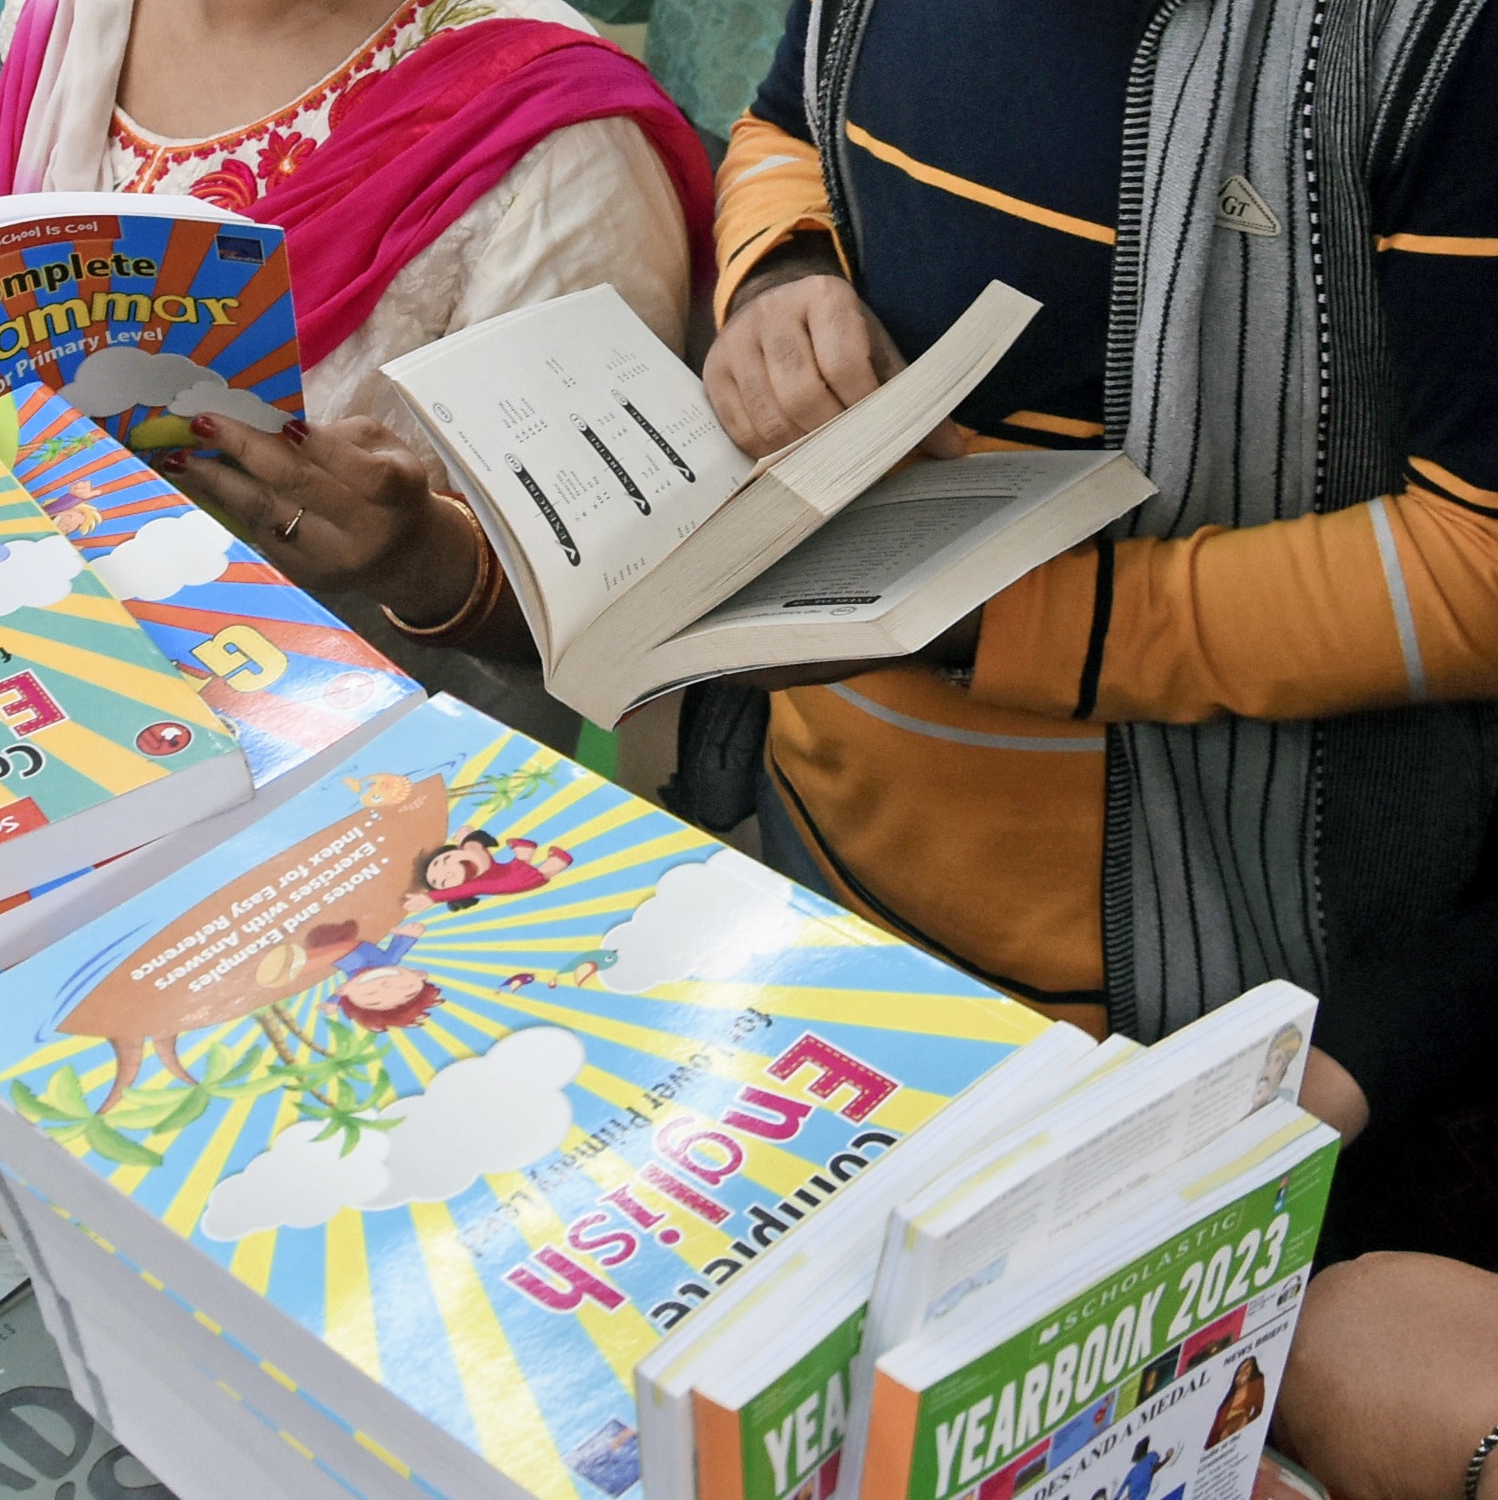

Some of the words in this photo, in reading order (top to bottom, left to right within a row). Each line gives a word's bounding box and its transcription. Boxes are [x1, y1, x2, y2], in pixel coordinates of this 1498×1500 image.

[46, 224, 61, 235] Is
[65, 221, 98, 234] Cool
[15, 333, 100, 378] Primary
[104, 327, 163, 346] Level
[587, 433, 635, 493] EXERCISE
[630, 409, 678, 463] EXERCISE
[523, 475, 567, 540] EXERCISE
[279, 864, 310, 889] for
[289, 841, 377, 903] Exercises
[308, 826, 365, 867] Index
[230, 885, 278, 919] Easy
[322, 862, 381, 904] Notes
[241, 900, 289, 934] with
[283, 901, 322, 934] and
[130, 915, 231, 981] Reference
[154, 931, 240, 991] Answers
[188, 927, 284, 993] Examples
[728, 1007, 774, 1043] for
[643, 1042, 734, 1111] Lower
[501, 1029, 905, 1314] English
[527, 1106, 654, 1193] Primary
[1063, 1212, 1237, 1327] SCHOLASTIC
[935, 1283, 1166, 1499] YEARBOOK
[1166, 1213, 1290, 1342] 2023
[1223, 1337, 1254, 1368] NEWS
[1255, 1321, 1289, 1349] BRIEFS
[1076, 1434, 1117, 1474] AND
[1117, 1423, 1134, 1442] A
[1133, 1369, 1212, 1431] MEDAL
